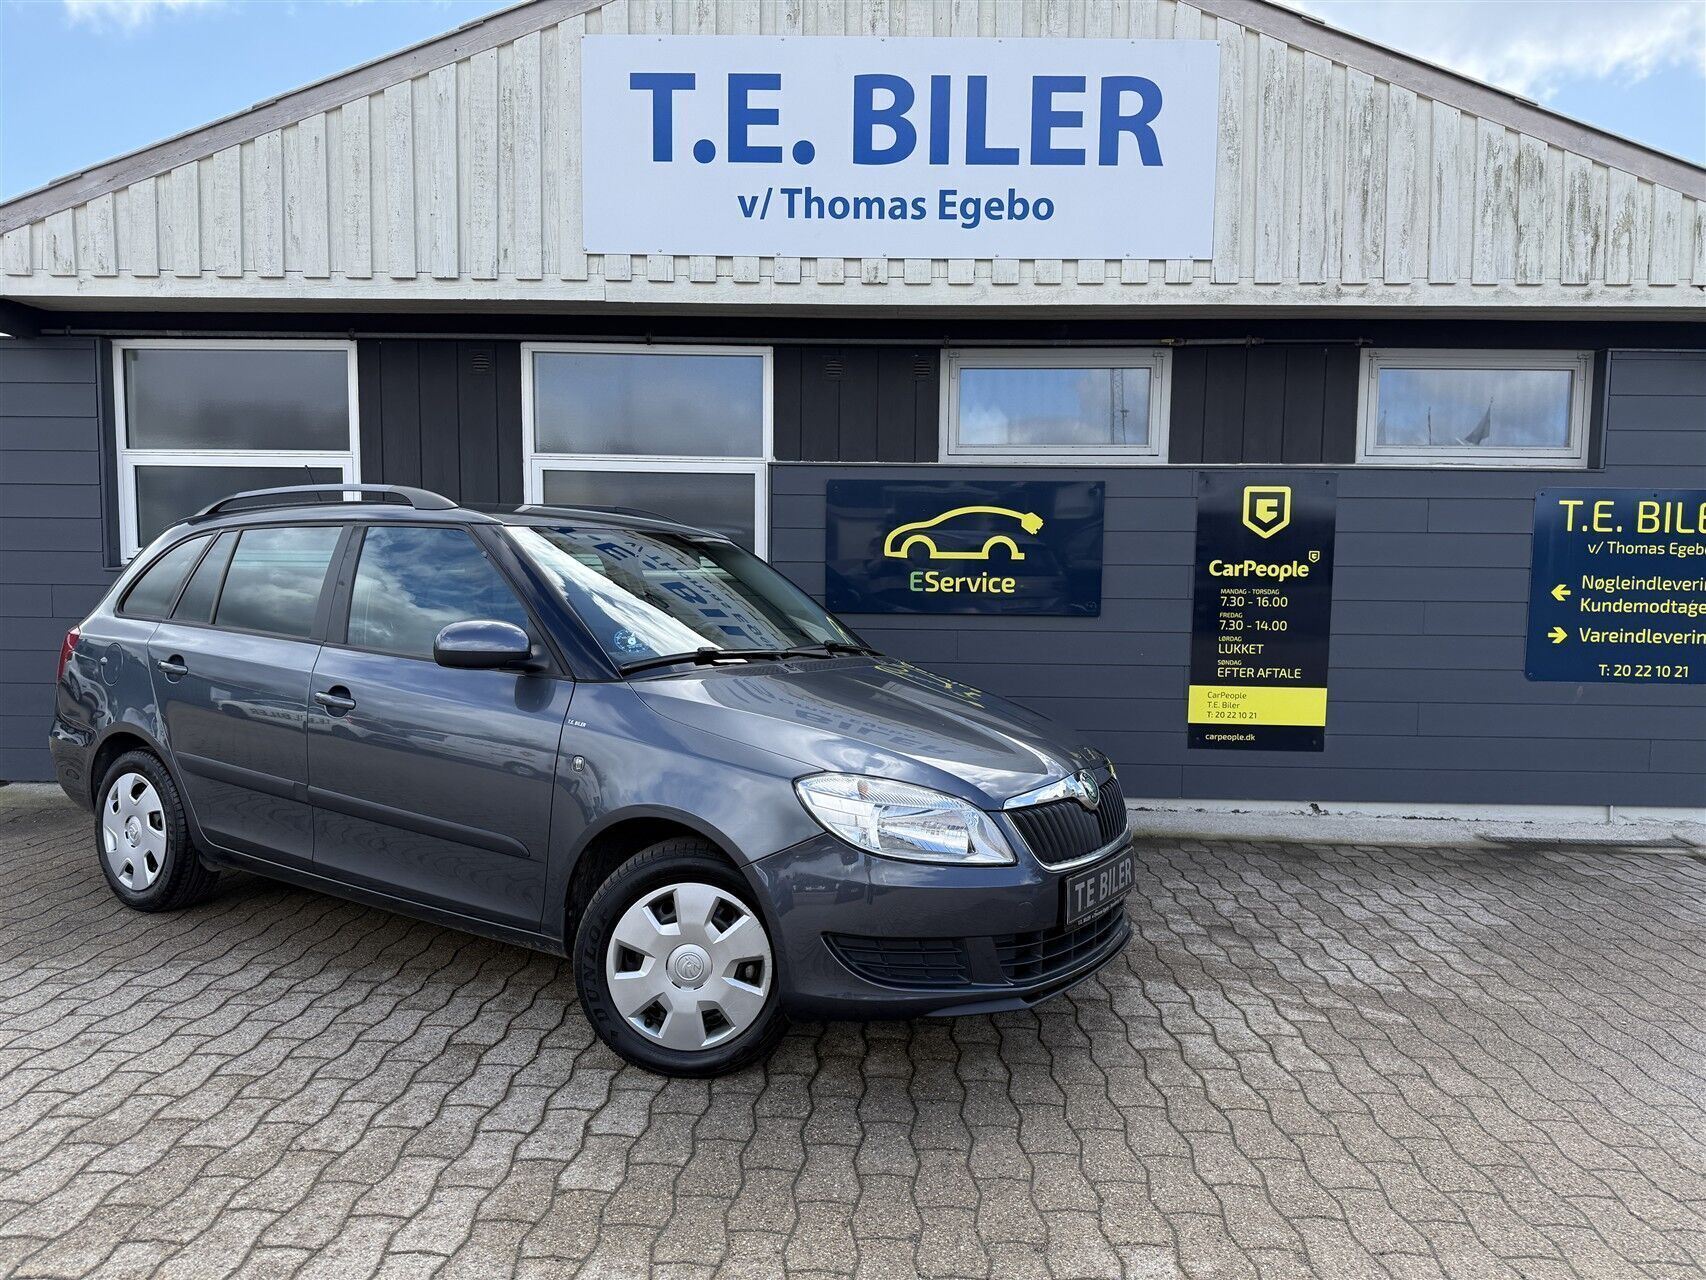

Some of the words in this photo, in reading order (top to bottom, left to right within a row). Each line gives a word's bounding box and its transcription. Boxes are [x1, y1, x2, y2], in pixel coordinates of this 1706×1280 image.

[630, 73, 815, 165] T.E.
[853, 74, 1163, 166] BILER
[737, 188, 773, 219] v/
[781, 187, 926, 220] Thomas
[939, 188, 1054, 229] Egebo
[1559, 500, 1622, 532] T.E.
[1588, 541, 1603, 554] v/
[1607, 541, 1665, 554] Thomas
[1670, 543, 1706, 558] Egeb
[1209, 560, 1310, 582] CarPeople
[910, 571, 1015, 593] EService
[1582, 575, 1706, 593] Nøgleindleveri
[1251, 588, 1280, 596] TORSDAG
[1220, 595, 1245, 607] 7.30
[1256, 596, 1288, 608] 16.00
[1219, 611, 1243, 619] FREDAG
[1219, 619, 1244, 631] 7.30
[1255, 620, 1288, 632] 14.00
[1218, 643, 1265, 655] LUKKET
[1217, 666, 1255, 678] EFTER
[1256, 667, 1302, 679] AFTALE
[1599, 664, 1609, 676] T:
[1614, 665, 1631, 676] 20
[1635, 665, 1651, 677] 22
[1656, 666, 1670, 677] 10
[1675, 666, 1688, 677] 21
[1207, 692, 1247, 702] CarPeople
[1206, 700, 1221, 709] T.E.
[1221, 701, 1241, 710] Biler
[1206, 710, 1214, 719] T:
[1215, 710, 1227, 719] 20
[1226, 711, 1237, 719] 22
[1238, 711, 1248, 720] 10
[1248, 711, 1257, 720] 21
[1205, 733, 1256, 742] carpeople.dk
[1099, 857, 1132, 901] BILER
